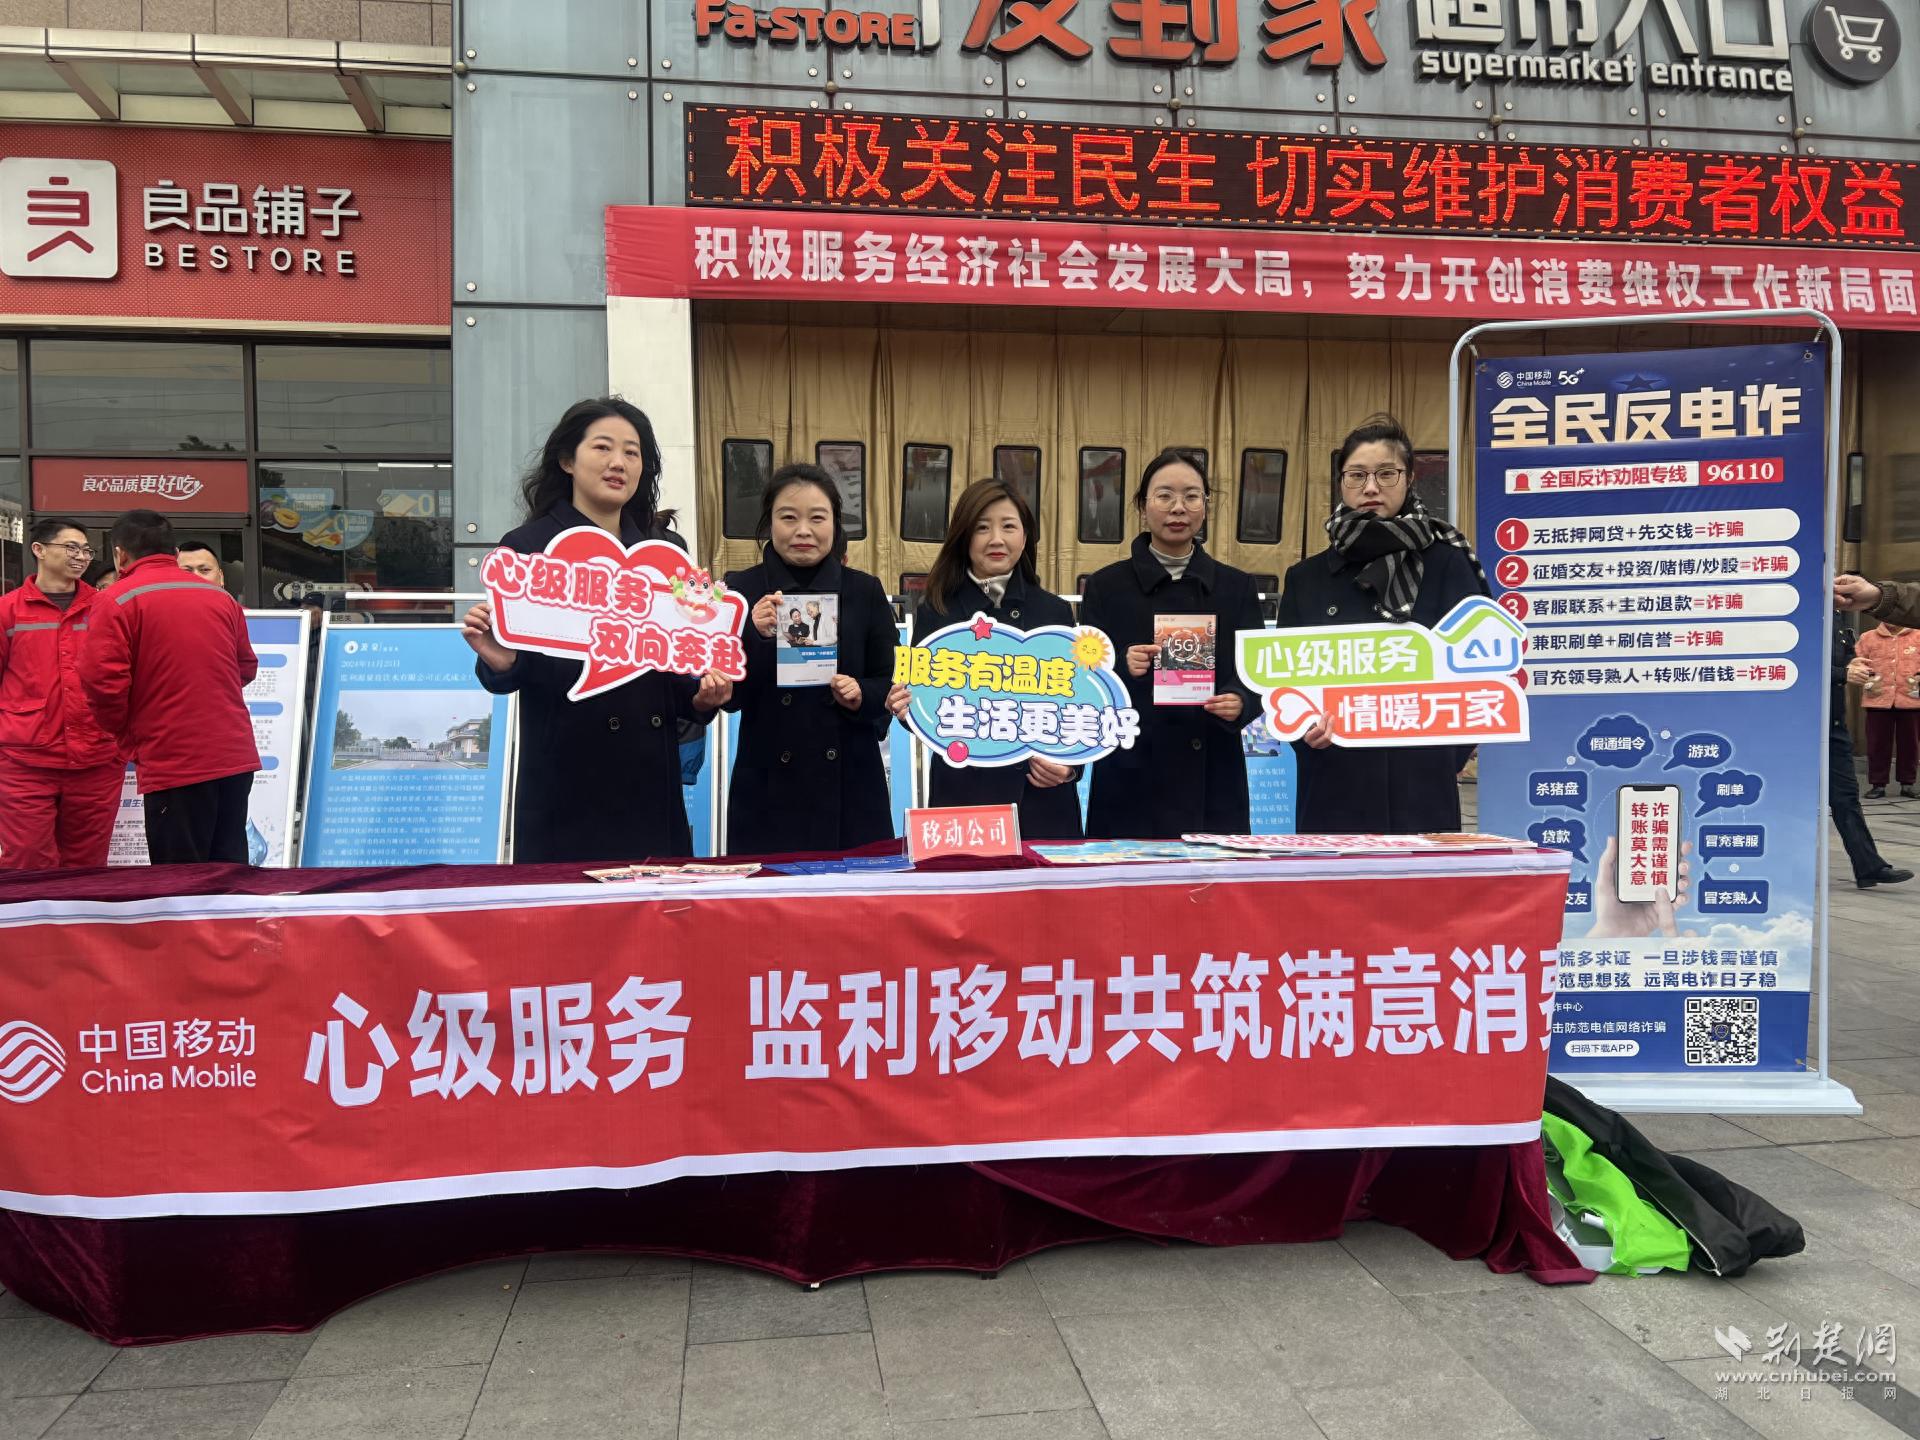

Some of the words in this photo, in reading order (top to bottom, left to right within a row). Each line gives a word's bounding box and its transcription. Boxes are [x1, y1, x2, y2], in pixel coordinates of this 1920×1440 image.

[1421, 51, 1637, 83] supermarket
[1651, 59, 1793, 92] entrance
[726, 116, 1221, 211] 积极关注民生
[1246, 139, 1906, 238] 切实维护消费者权益
[143, 179, 359, 237] 良品铺子
[144, 242, 355, 274] BESTORE
[1516, 371, 1552, 381] 中国移动
[1489, 383, 1802, 449] 全民反电诈
[82, 474, 201, 496] 良心品质更好吃
[1540, 464, 1687, 489] 全国反诈劝阻专线
[1706, 461, 1775, 483] 96110
[1505, 525, 1516, 545] 1
[1533, 520, 1744, 545] 无抵押网贷+先交钱=诈骗
[1505, 561, 1519, 581] 2
[1533, 555, 1789, 581] 征婚交友+投资/赌博/炒股=诈骗
[485, 551, 650, 616] 心级服务
[1533, 593, 1743, 616] 客服联系+主动退款=诈骗
[593, 620, 745, 677] 双向奔赴
[1174, 639, 1194, 652] 5G
[1532, 630, 1724, 651] 兼职刷单+刷信誉=诈骗
[1255, 635, 1418, 679] 心级服务
[893, 645, 1076, 697] 服务有温度
[1533, 663, 1787, 686] 冒充领导熟人+转账/借钱=诈骗
[935, 695, 1141, 749] 生活更美好
[1338, 688, 1507, 732] 情暖万家
[1590, 736, 1647, 752] 假通缉令
[1688, 743, 1720, 759] 游戏
[1536, 782, 1579, 796] 杀猪盘
[1716, 782, 1745, 797] 刷单
[921, 816, 1007, 849] 移动公司
[1542, 829, 1571, 844] 贷款
[1630, 802, 1649, 887] 转账莫大意
[1650, 801, 1670, 887] 诈骗需谨慎
[1704, 833, 1760, 848] 冒充客服
[1703, 890, 1762, 906] 冒充熟人
[1643, 949, 1779, 967] 一旦涉钱需谨慎
[1558, 972, 1631, 988] 范思想弦
[1643, 971, 1777, 988] 远离电诈日子稳
[303, 975, 692, 1107] 心级服务
[744, 944, 1559, 1082] 监利移动共筑满意消
[1552, 1020, 1667, 1034] 击防范电信网络诈骗
[78, 1016, 257, 1063] 中国移动
[1570, 1043, 1634, 1054] 扫码下载APP
[81, 1067, 165, 1095] China
[171, 1062, 257, 1090] Mobile
